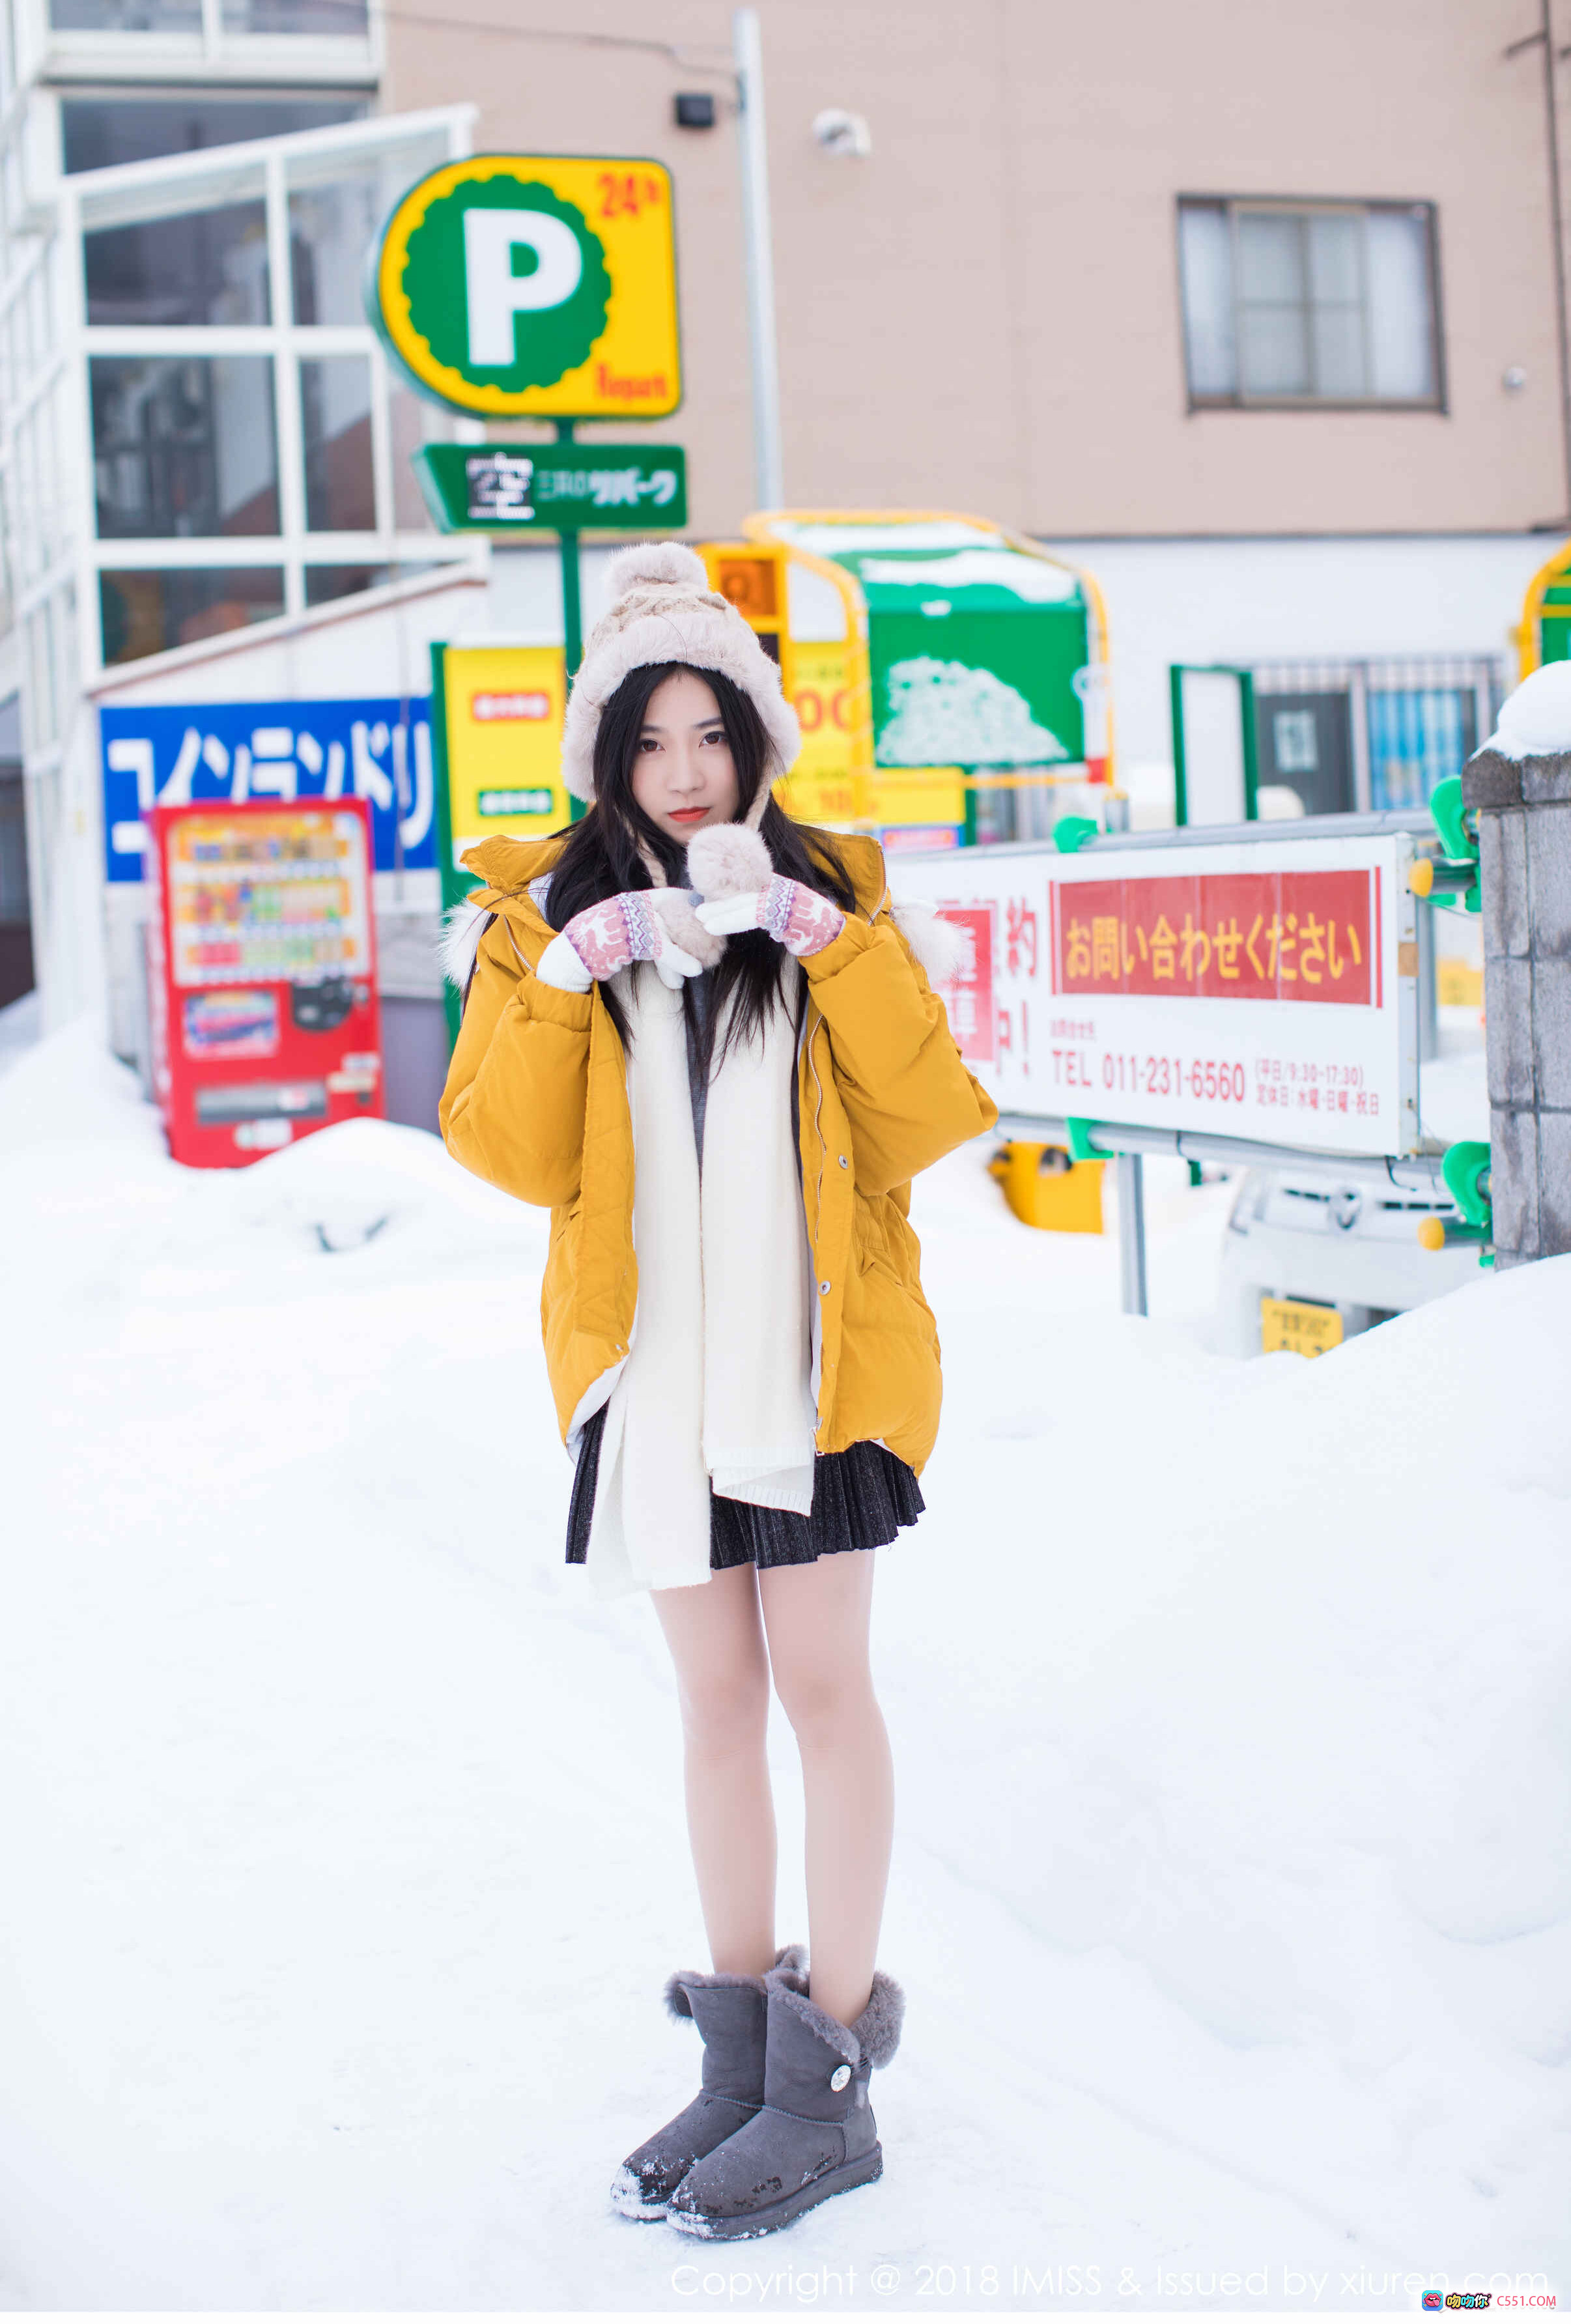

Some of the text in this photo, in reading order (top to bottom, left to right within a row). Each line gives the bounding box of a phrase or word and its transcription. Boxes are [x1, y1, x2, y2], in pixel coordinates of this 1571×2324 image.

[462, 207, 584, 366] P
[465, 452, 535, 520] 空
[1066, 913, 1362, 984] お問い合わせください
[1052, 1050, 1245, 1102] TEL 011-231-6560
